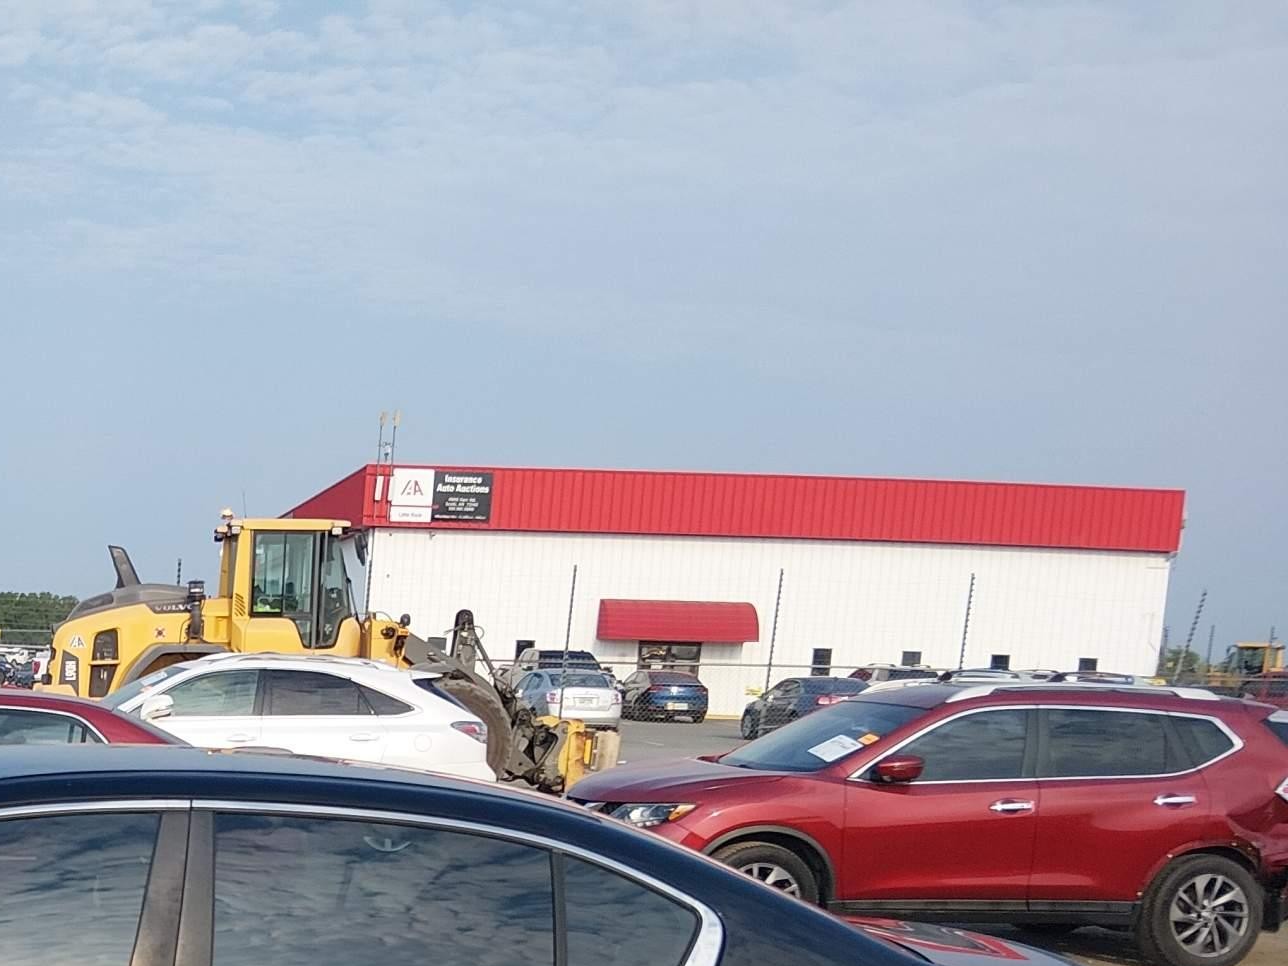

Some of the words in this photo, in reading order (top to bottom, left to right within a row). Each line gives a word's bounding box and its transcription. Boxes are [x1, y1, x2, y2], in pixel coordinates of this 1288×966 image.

[444, 474, 482, 484] Insurance
[436, 483, 455, 492] Auto
[455, 484, 490, 494] Auctions
